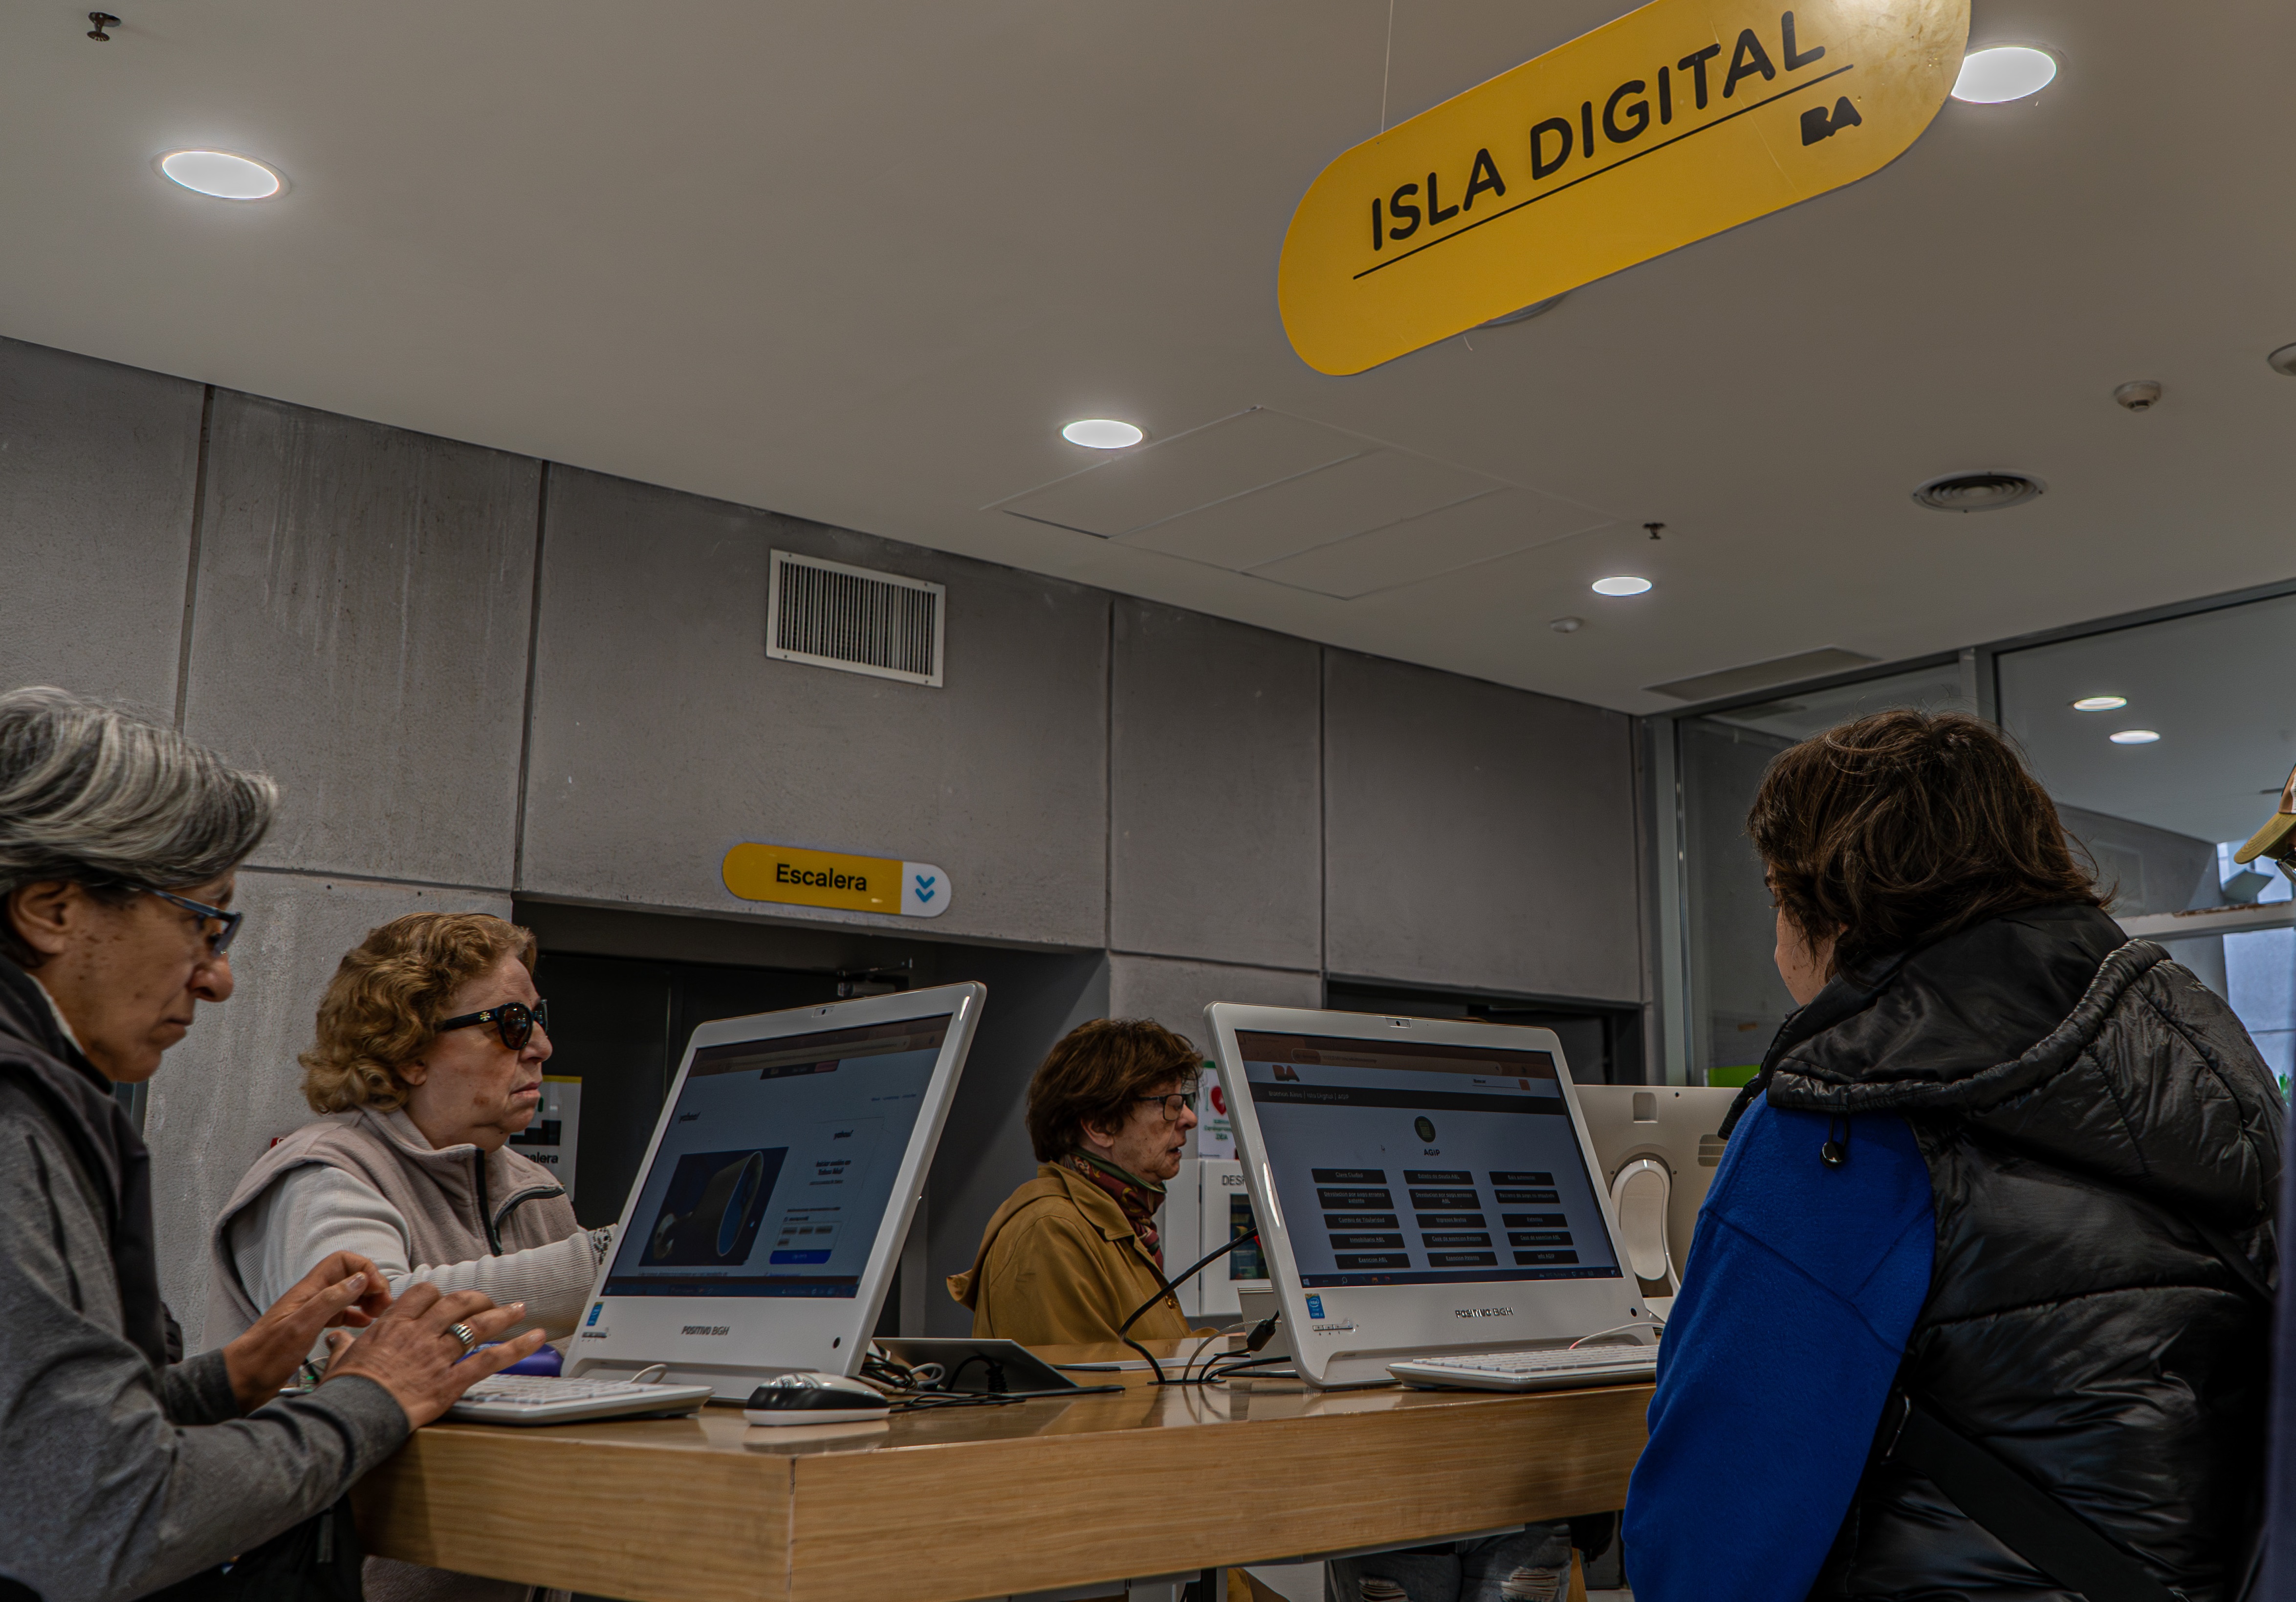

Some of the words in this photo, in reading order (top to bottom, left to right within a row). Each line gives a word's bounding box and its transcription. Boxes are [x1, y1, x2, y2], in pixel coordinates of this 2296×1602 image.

[1372, 148, 1506, 251] ISLA
[1530, 10, 1826, 180] DIGITAL
[776, 862, 867, 892] Escalera
[523, 1152, 558, 1163] alera
[1455, 1309, 1491, 1318] POSITIVO
[1492, 1307, 1514, 1316] BGH
[681, 1325, 712, 1335] POSITIVO
[712, 1326, 730, 1335] BGH
